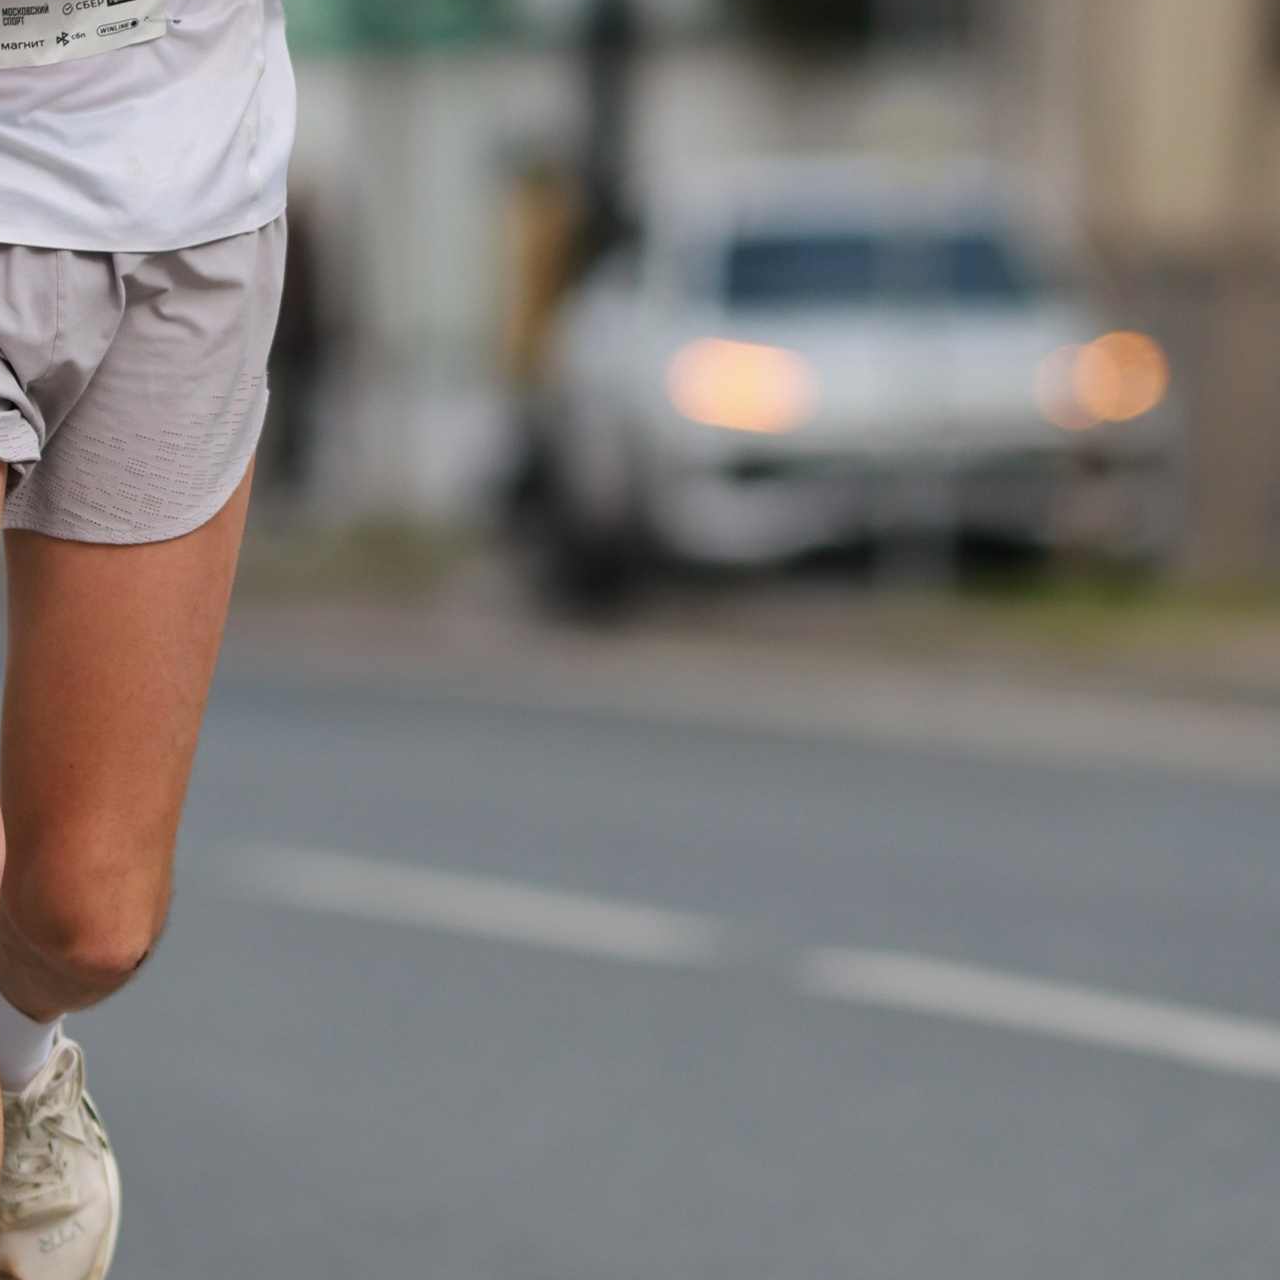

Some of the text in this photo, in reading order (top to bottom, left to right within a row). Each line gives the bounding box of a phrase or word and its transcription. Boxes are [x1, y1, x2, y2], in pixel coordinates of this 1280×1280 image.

[1, 2, 50, 17] МОСКОВСКИЙ
[2, 16, 25, 27] СПОРТ
[99, 21, 130, 35] WINLINE
